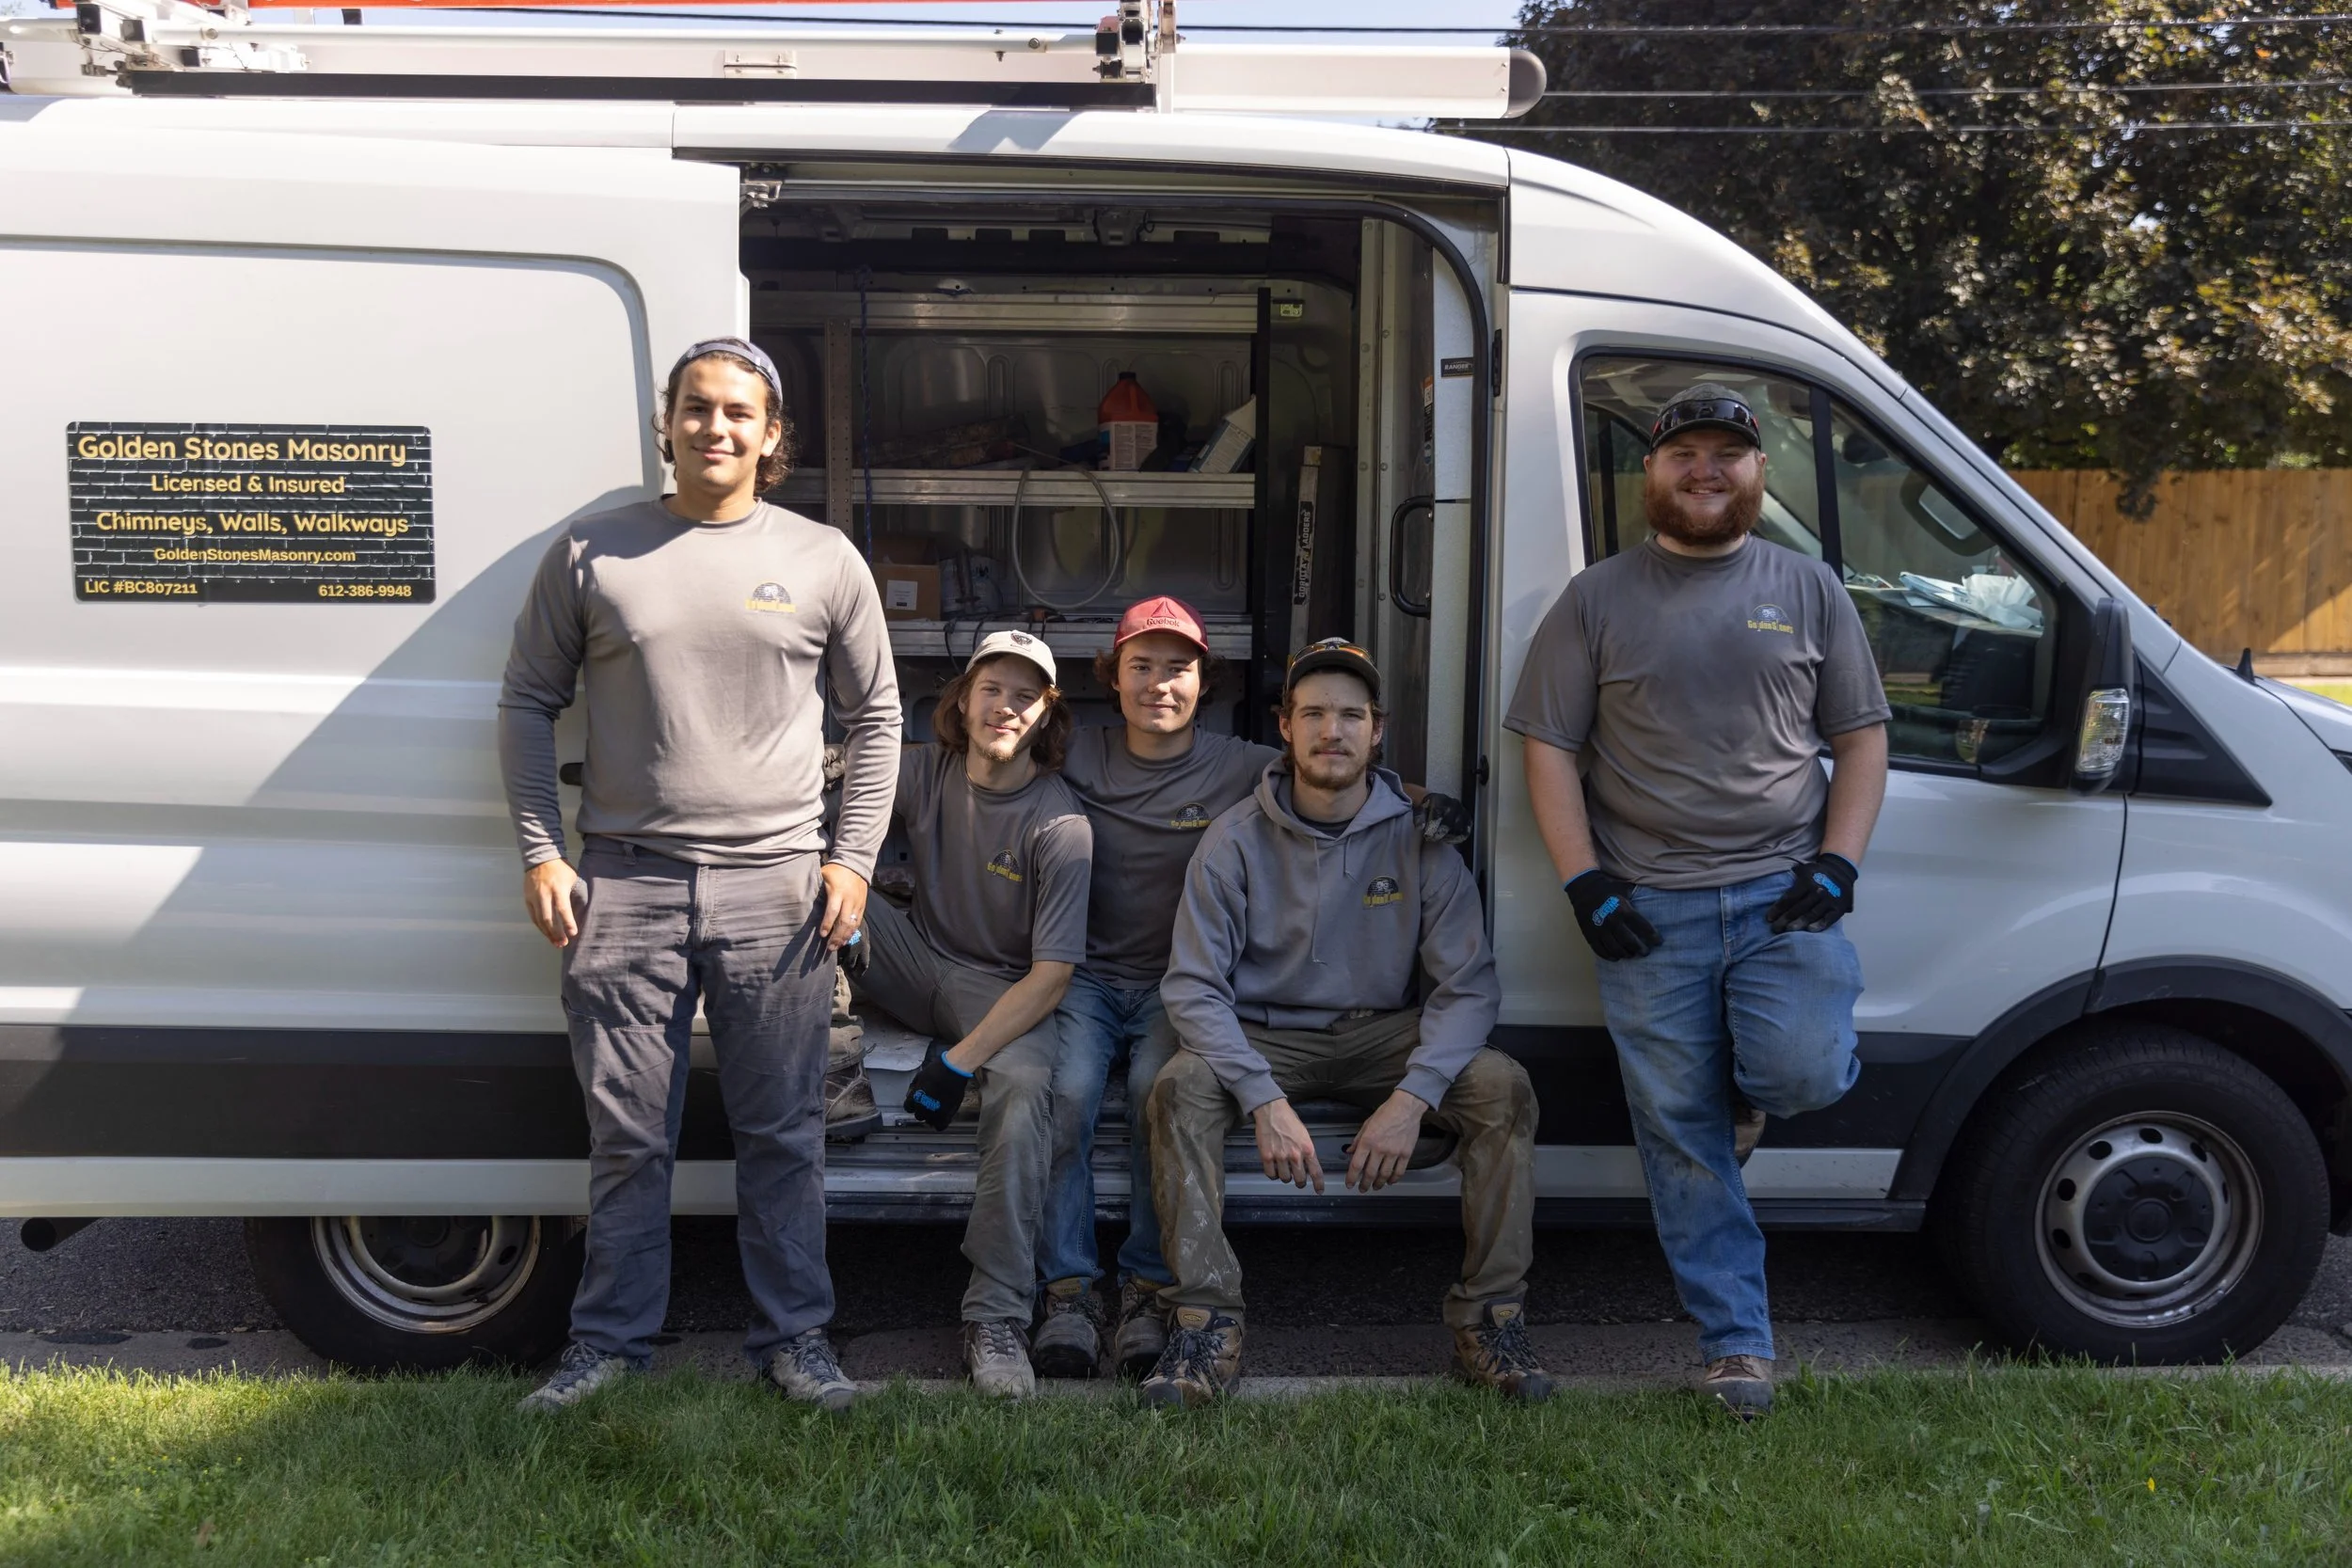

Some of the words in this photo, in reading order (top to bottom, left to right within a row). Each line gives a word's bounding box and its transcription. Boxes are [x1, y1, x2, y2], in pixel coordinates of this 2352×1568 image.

[78, 436, 176, 459] Golden
[184, 436, 279, 461] Stones
[288, 438, 406, 467] Masonry
[151, 474, 242, 492] Licensed
[246, 475, 263, 493] &
[268, 476, 345, 494] Insured
[96, 512, 214, 535] Chimneys,
[218, 513, 287, 534] Walls,
[294, 514, 409, 537] Walkways
[153, 547, 357, 564] GoldenStonesMasonry.com
[85, 580, 110, 594] LIC
[113, 580, 198, 595] #BC807211
[318, 584, 412, 597] 612-386-9948
[1147, 618, 1180, 627] Reebok
